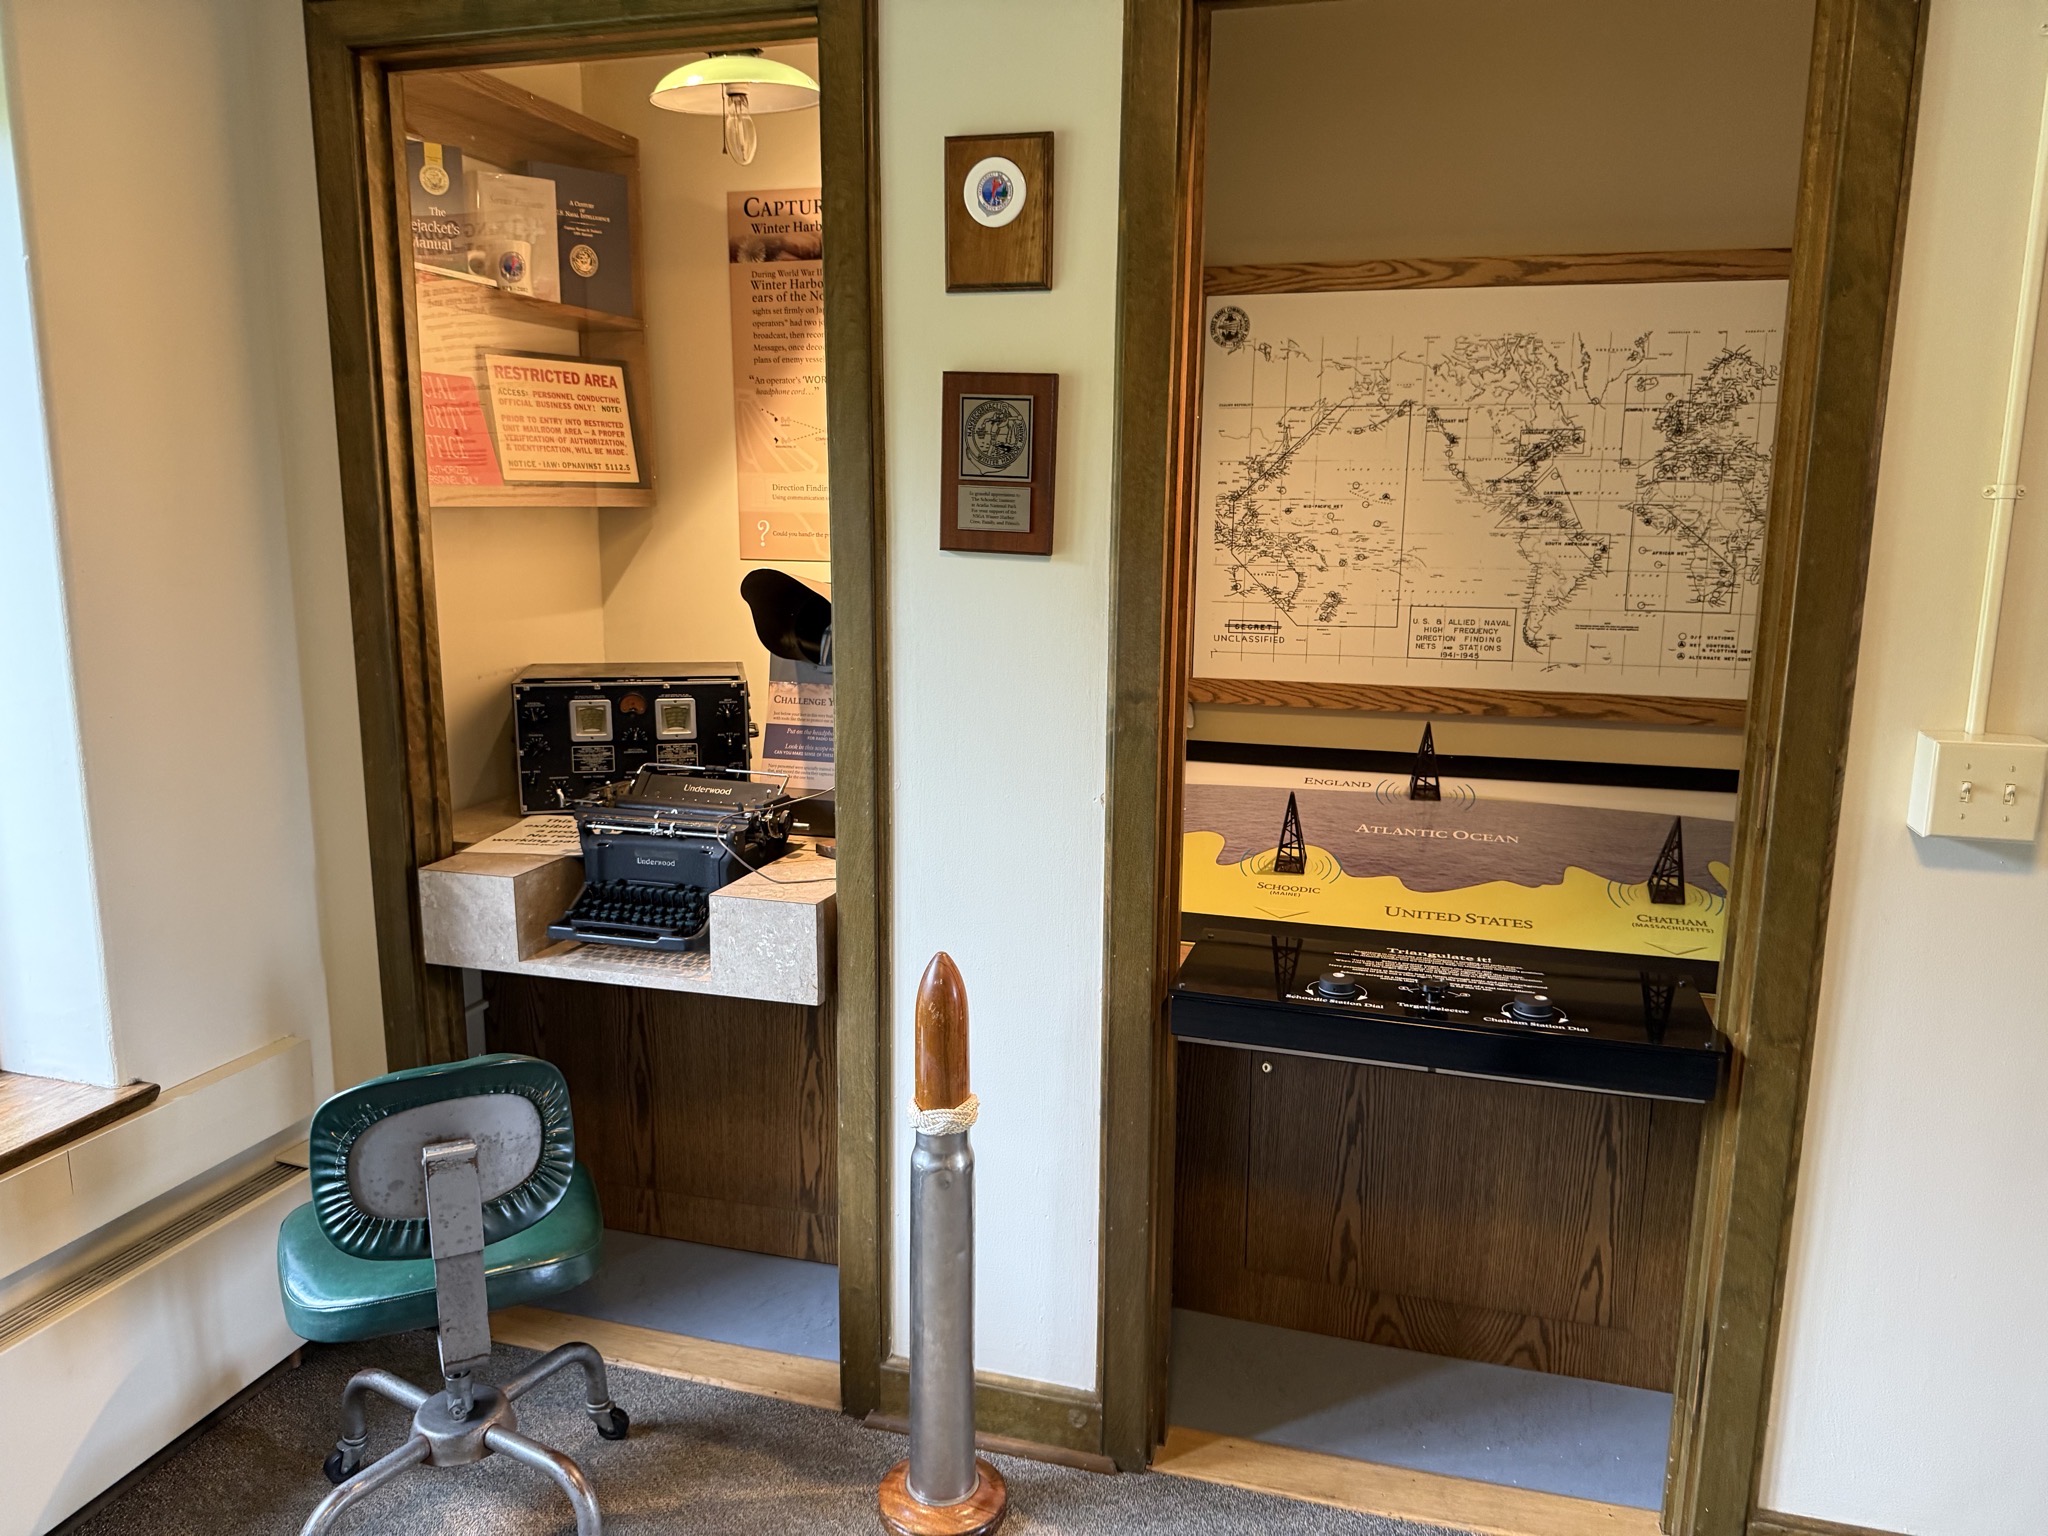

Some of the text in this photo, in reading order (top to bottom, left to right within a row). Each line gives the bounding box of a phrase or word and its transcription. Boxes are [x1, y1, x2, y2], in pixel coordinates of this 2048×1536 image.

[428, 206, 447, 218] The
[411, 219, 460, 236] ejacket's
[750, 220, 823, 234] Winter Harb
[751, 270, 777, 279] During
[777, 269, 799, 277] World
[800, 269, 815, 277] War
[750, 279, 787, 290] Winter
[752, 293, 774, 303] ears
[776, 291, 788, 302] of
[790, 290, 807, 302] the
[752, 307, 772, 316] sights
[784, 306, 804, 316] firmly
[789, 318, 803, 326] had
[753, 331, 788, 340] broadcast,
[789, 331, 805, 339] then
[753, 344, 787, 353] Messages,
[753, 356, 804, 365] plans of enemy
[493, 364, 618, 389] RESTRICTED AREA
[766, 376, 801, 386] operator's
[497, 388, 621, 404] ACCESS: PERSONNEL CONDUCTING
[755, 388, 790, 397] headphone
[499, 398, 622, 413] OFFICIAL BUSINESS ONLY! NOTE:
[501, 414, 524, 422] PRIOR
[539, 417, 562, 425] ENTRY
[565, 418, 582, 426] INTO
[584, 419, 624, 429] RESTRICTED
[523, 426, 561, 435] MAILROOM
[599, 430, 625, 438] PROPER
[504, 434, 555, 443] VERIFICATION
[570, 438, 627, 447] AUTHORIZATION,
[514, 444, 574, 454] IDENTIFICATION,
[508, 460, 537, 468] NOTICE
[562, 462, 602, 470] OPNAVINST
[772, 483, 805, 491] Direction
[757, 519, 770, 547] ?
[1213, 634, 1285, 644] UNCLASSIFIED
[1440, 652, 1480, 660] 1941-1945
[773, 694, 827, 706] CHALLENGE
[1303, 777, 1372, 788] ENGLAND
[683, 783, 733, 796] Underwood
[1355, 823, 1519, 844] ATLANTIC OCEAN
[636, 857, 676, 867] Underwood
[1256, 881, 1321, 894] SCHOODIC
[1269, 889, 1301, 898] (MAINE)
[1384, 905, 1534, 930] UNITED STATES
[1635, 914, 1708, 928] CHATHAM
[1631, 922, 1715, 934] (MASSACHUSETTS)
[1386, 947, 1474, 961] Triangulate
[1285, 993, 1384, 1009] Schoodic Station Dial
[1396, 1001, 1470, 1014] Target Selector
[1483, 1016, 1529, 1026] Chatham
[1530, 1022, 1566, 1030] Station
